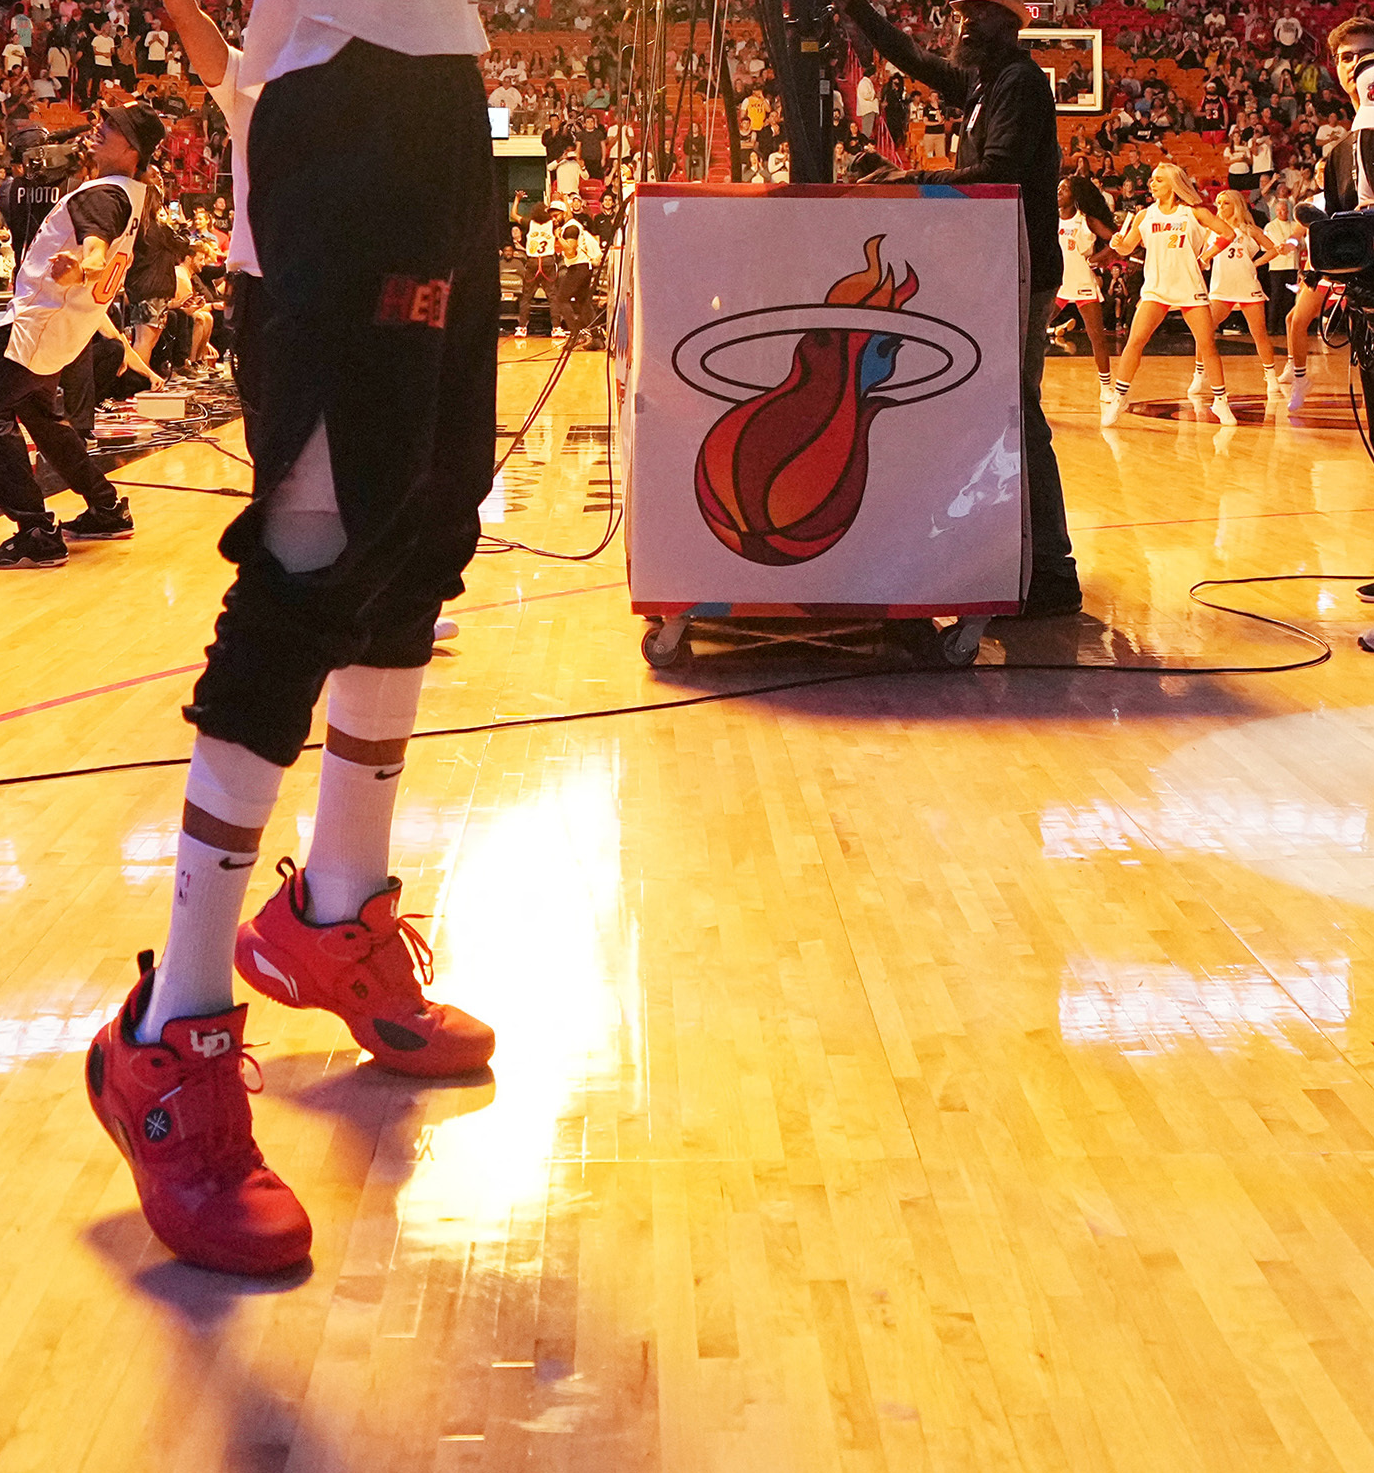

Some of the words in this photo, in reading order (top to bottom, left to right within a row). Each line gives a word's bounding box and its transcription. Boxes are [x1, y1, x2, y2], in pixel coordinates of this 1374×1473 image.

[1151, 221, 1187, 234] MIAMI
[1167, 234, 1186, 249] 21
[1227, 247, 1244, 258] 35
